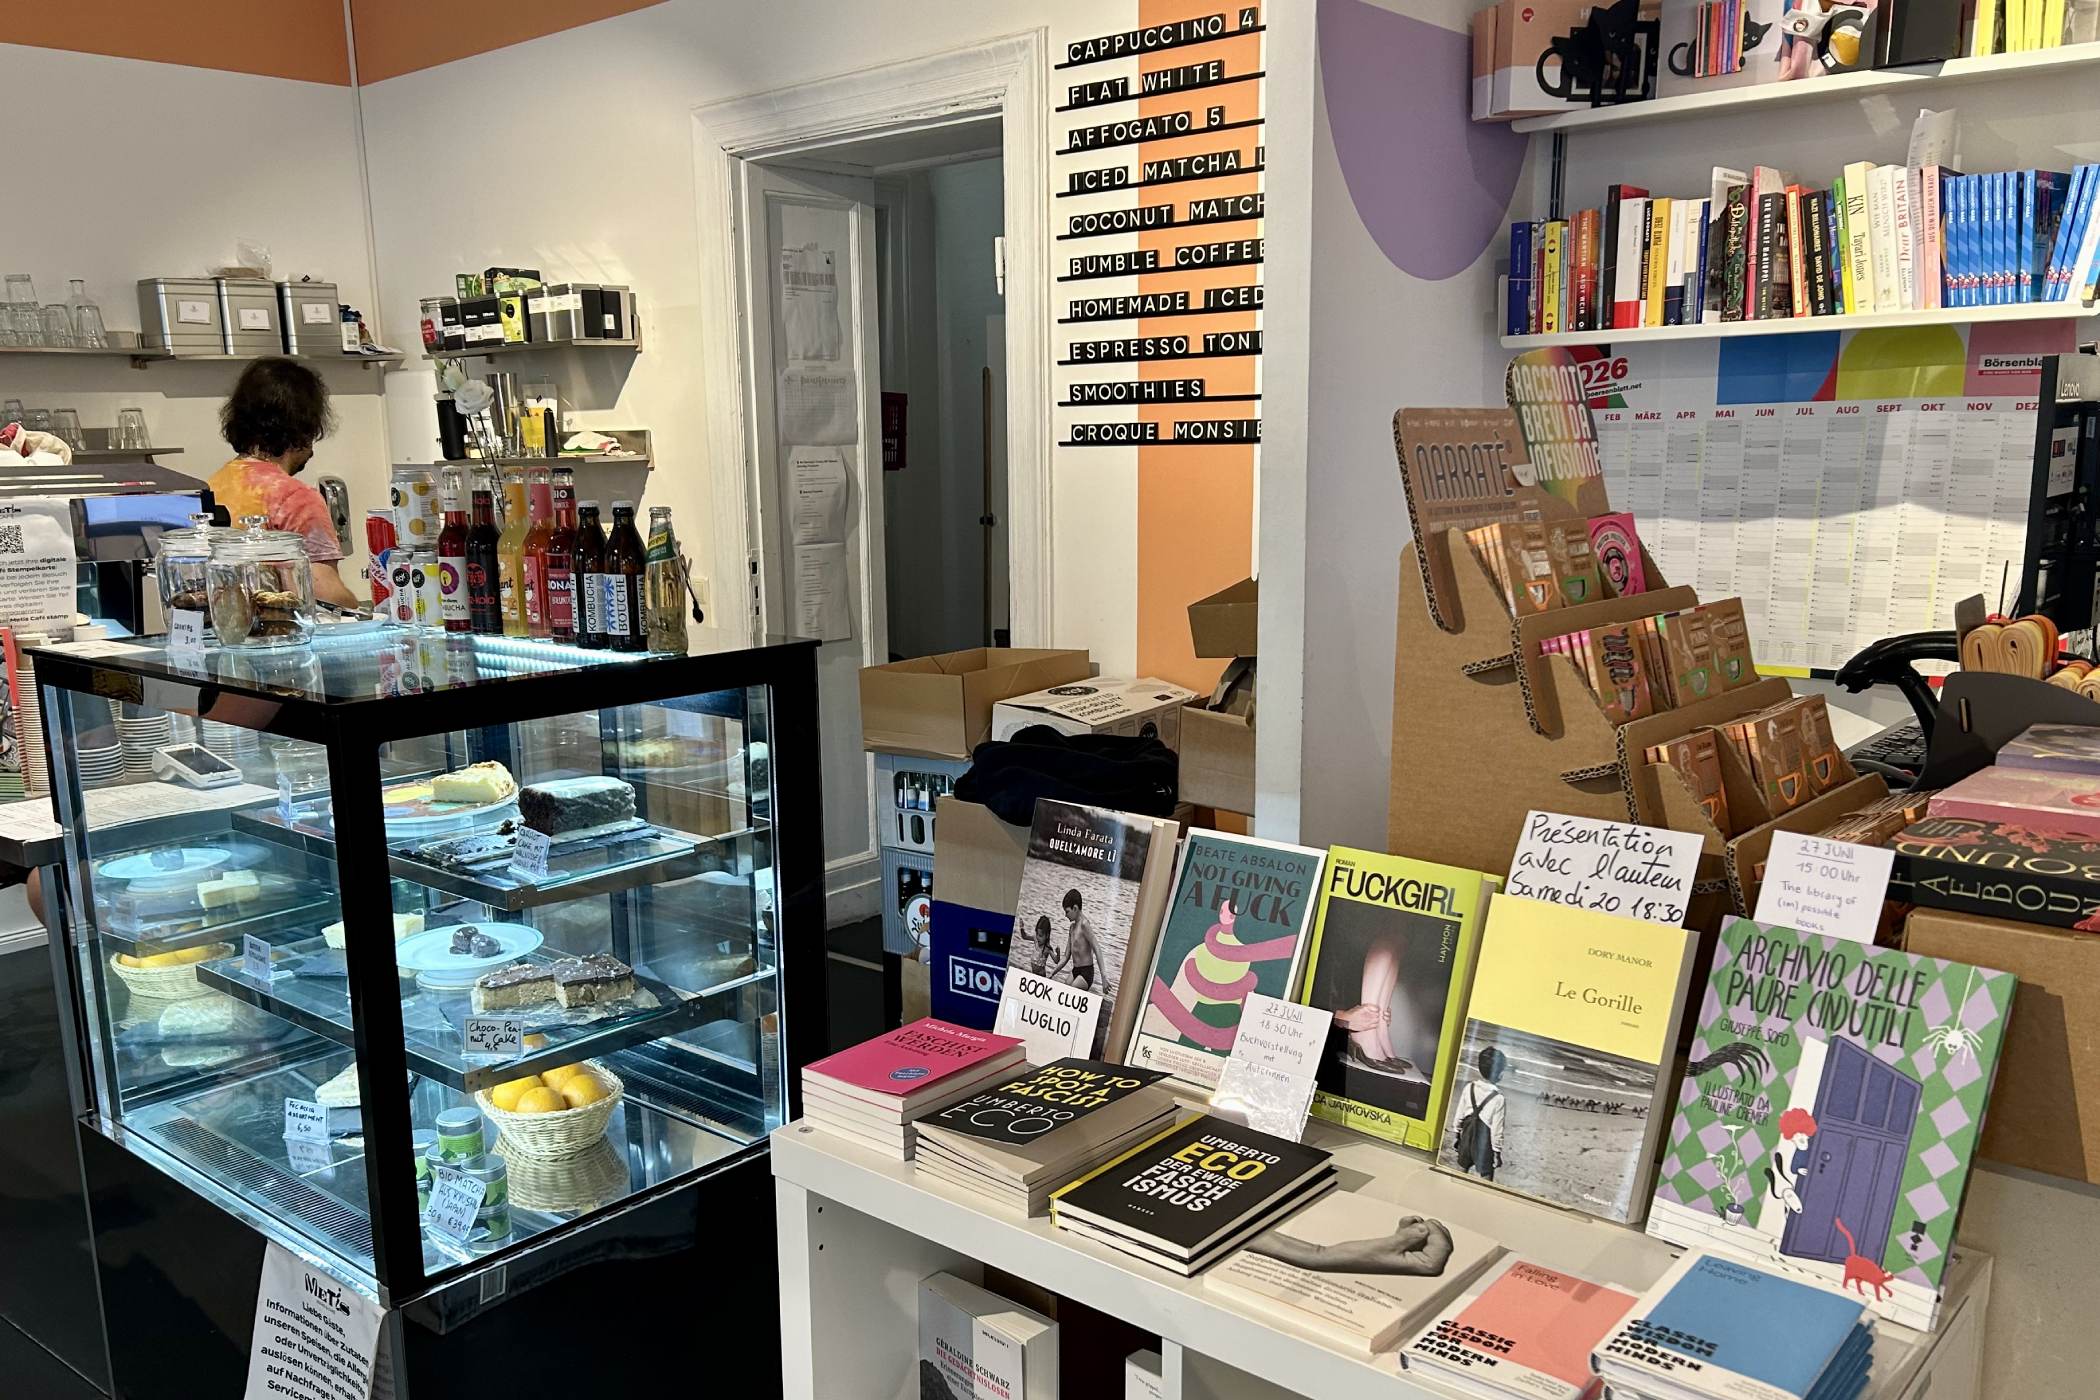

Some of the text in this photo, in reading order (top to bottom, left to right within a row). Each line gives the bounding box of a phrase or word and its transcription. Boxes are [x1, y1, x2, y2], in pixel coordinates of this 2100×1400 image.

[1069, 9, 1254, 61] CAPPUCCINO 4
[1071, 62, 1219, 104] FLAT WHITE
[1070, 108, 1220, 148] AFFOGATO 5
[1074, 152, 1237, 190] ICED MATCHA
[1070, 206, 1171, 233] COCONUT
[1848, 195, 1865, 216] KIN
[1810, 197, 1822, 252] NAZI BILLIONAIRES
[1896, 180, 1911, 262] Dear BRITAIN
[1072, 251, 1155, 276] BUMBLE
[1815, 256, 1823, 273] DAVID
[1852, 232, 1867, 281] Tayari Jones
[1071, 286, 1263, 318] HOMEMADE ICED
[1073, 332, 1263, 360] ESPRESSO TONI
[1072, 380, 1201, 402] SMOOTHIES
[1512, 365, 1586, 402] RACCONTI
[2061, 380, 2079, 398] Lenovo
[1635, 411, 1661, 420] MÄRZ
[1715, 410, 1735, 418] MAI
[1755, 409, 1774, 417] JUN
[1796, 408, 1814, 416] JUL
[1836, 406, 1859, 414] AUG
[1877, 404, 1902, 412] SEPT
[1921, 403, 1945, 411] OKT
[1967, 403, 1992, 411] NOV
[2016, 402, 2038, 410] DEZ
[1072, 423, 1155, 441] CROQUE
[1522, 403, 1591, 442] BREVI DA
[588, 575, 596, 632] KOMBUCHA
[617, 578, 628, 632] BOUCHE
[1057, 822, 1113, 845] Linda Farata
[1530, 814, 1673, 856] Présentation
[1049, 838, 1104, 860] QUELL'AMORE
[1196, 845, 1307, 875] BEATE ABSALON
[1518, 848, 1573, 875] avec
[1801, 839, 1854, 859] 27 JUNI
[1189, 862, 1302, 898] NOT GIVING
[1841, 870, 1860, 883] Uhr
[1183, 881, 1296, 927] A FUCK
[1330, 866, 1464, 919] FUCKGIRL
[1510, 871, 1683, 923] Samedi 20 18:30
[1780, 880, 1843, 908] The library
[1795, 918, 1825, 931] books
[1437, 924, 1452, 964] HAYMON
[1588, 948, 1653, 968] DORY MANOR
[1732, 934, 1928, 1010] ARCHIVIO DELLE
[1019, 977, 1089, 1013] BOOK CLUB
[1554, 981, 1643, 1015] Le Gorille
[1021, 1005, 1071, 1037] LUGLIO
[1266, 1002, 1303, 1021] 27 JUNI
[1725, 970, 1912, 1049] PAURE (IN)UTILI
[493, 1034, 517, 1044] Cake
[894, 1035, 968, 1057] WERDEN
[904, 1030, 988, 1052] FASCHIST
[1288, 1027, 1303, 1038] Uhr
[1719, 1018, 1790, 1048] GIUSEPPE SOFO
[1240, 1032, 1303, 1064] Buchvorstellung
[1028, 1074, 1111, 1097] SPOT A
[1039, 1066, 1141, 1090] HOW TO
[972, 1095, 1075, 1121] UMBERTO
[998, 1081, 1110, 1108] FASCIST
[1701, 1095, 1732, 1116] PAULINE
[1704, 1081, 1769, 1112] ILLUSTRATO DA
[940, 1102, 1055, 1135] ECO
[1329, 1098, 1392, 1126] JANKOVSKA
[1170, 1142, 1267, 1180] ECO
[1200, 1134, 1281, 1165] UMBERTO
[439, 1169, 486, 1195] BIO MATCHA
[1141, 1166, 1232, 1202] FASCH
[1159, 1158, 1243, 1191] DER EWIGE
[1121, 1176, 1212, 1212] ISMUS
[1517, 1264, 1559, 1283] Falling
[302, 1301, 322, 1320] Liebe
[264, 1315, 346, 1366] unseren Speisen, die
[267, 1299, 369, 1367] Informationen über Zutaten
[275, 1335, 296, 1350] oder
[1427, 1331, 1463, 1345] FOR
[1435, 1325, 1512, 1354] WISDOM
[1440, 1320, 1517, 1348] CLASSIC
[1618, 1331, 1659, 1347] FOR
[1627, 1325, 1714, 1357] WISDOM
[1631, 1319, 1719, 1350] CLASSIC
[936, 1347, 947, 1358] DIE
[1413, 1343, 1474, 1367] MINDS
[1419, 1337, 1499, 1367] MODERN
[1605, 1345, 1675, 1371] MINDS
[1611, 1338, 1702, 1372] MODERN
[261, 1346, 334, 1389] auslösen können,
[975, 1363, 1010, 1389] SCHWARZ
[267, 1365, 331, 1399] auf Nachfrage
